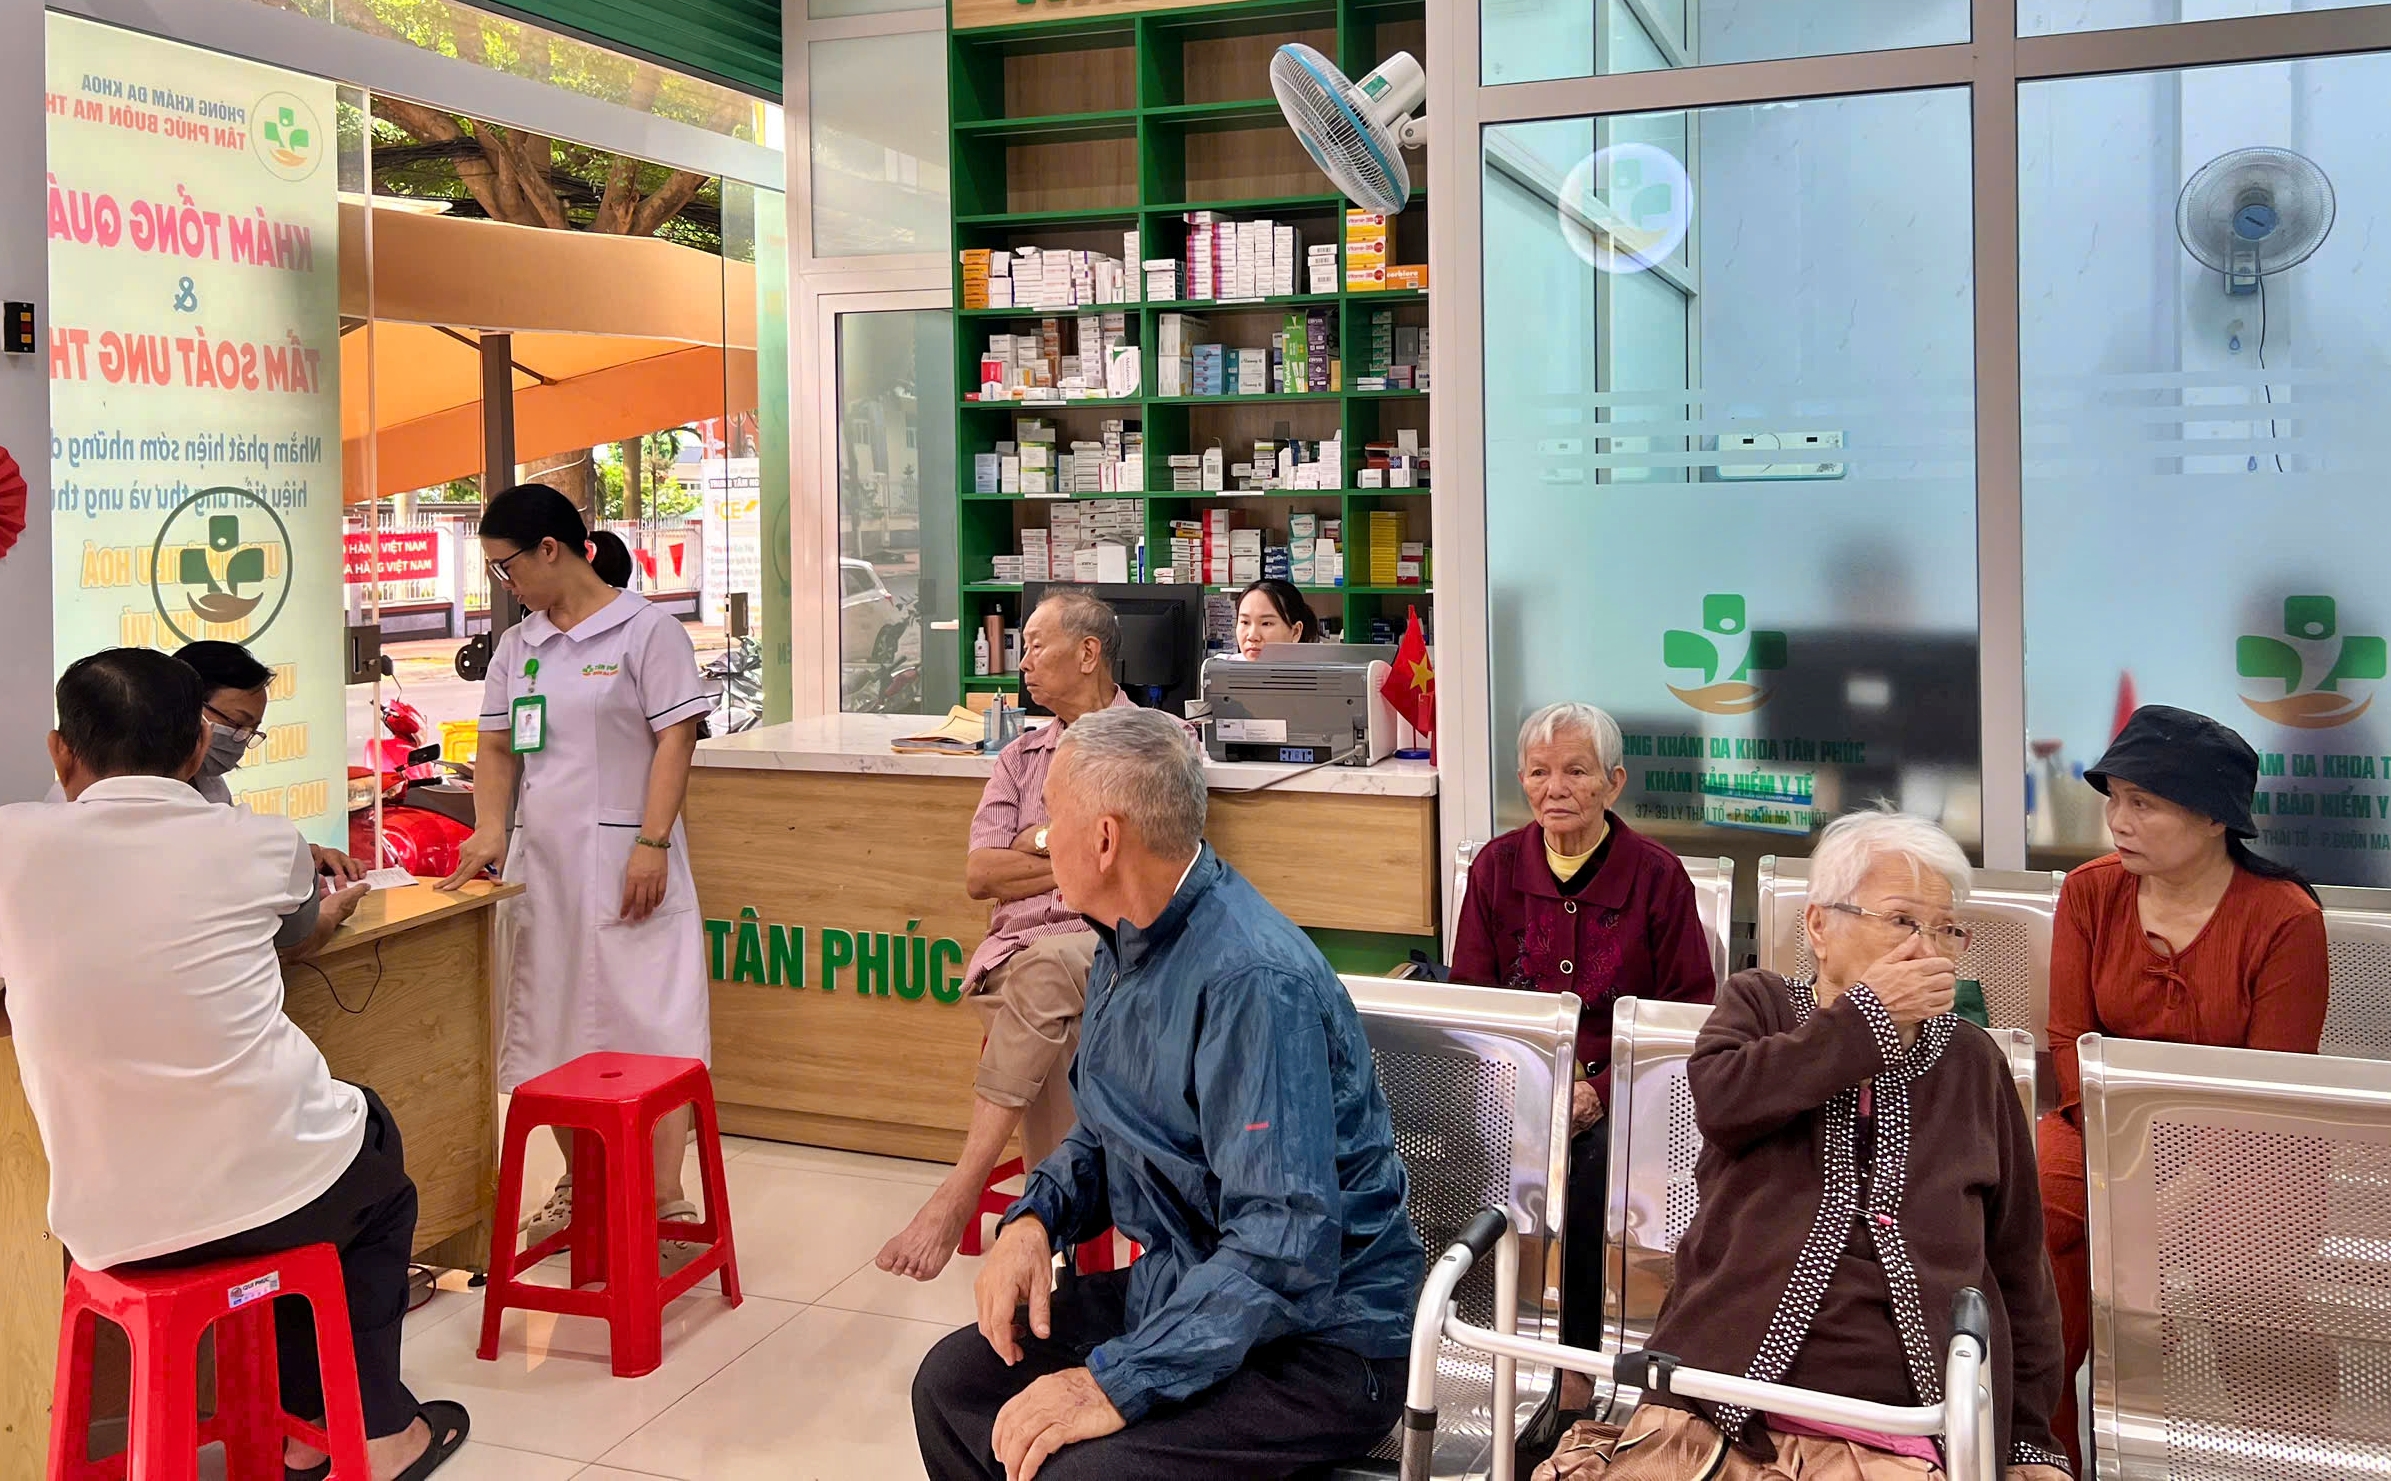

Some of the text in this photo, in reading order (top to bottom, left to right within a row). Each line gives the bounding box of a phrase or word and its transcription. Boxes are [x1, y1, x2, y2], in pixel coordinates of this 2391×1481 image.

[349, 540, 377, 554] HÀN
[381, 540, 403, 555] VIỆT
[405, 540, 427, 553] NAM
[354, 560, 384, 574] HÀG
[386, 558, 408, 574] VIỆT
[410, 559, 432, 571] NAM
[1657, 732, 1704, 759] KHÁM
[1710, 737, 1731, 759] ĐA
[1735, 737, 1780, 761] KHOA
[2323, 754, 2376, 779] KHOA
[1645, 767, 1693, 793] KHÁM
[1780, 775, 1791, 796] Y
[1795, 770, 1814, 797] TẾ
[1775, 810, 1791, 826] MA
[2377, 795, 2390, 819] Y
[2371, 832, 2391, 850] MA
[705, 905, 964, 1004] TÂN PHÚC
